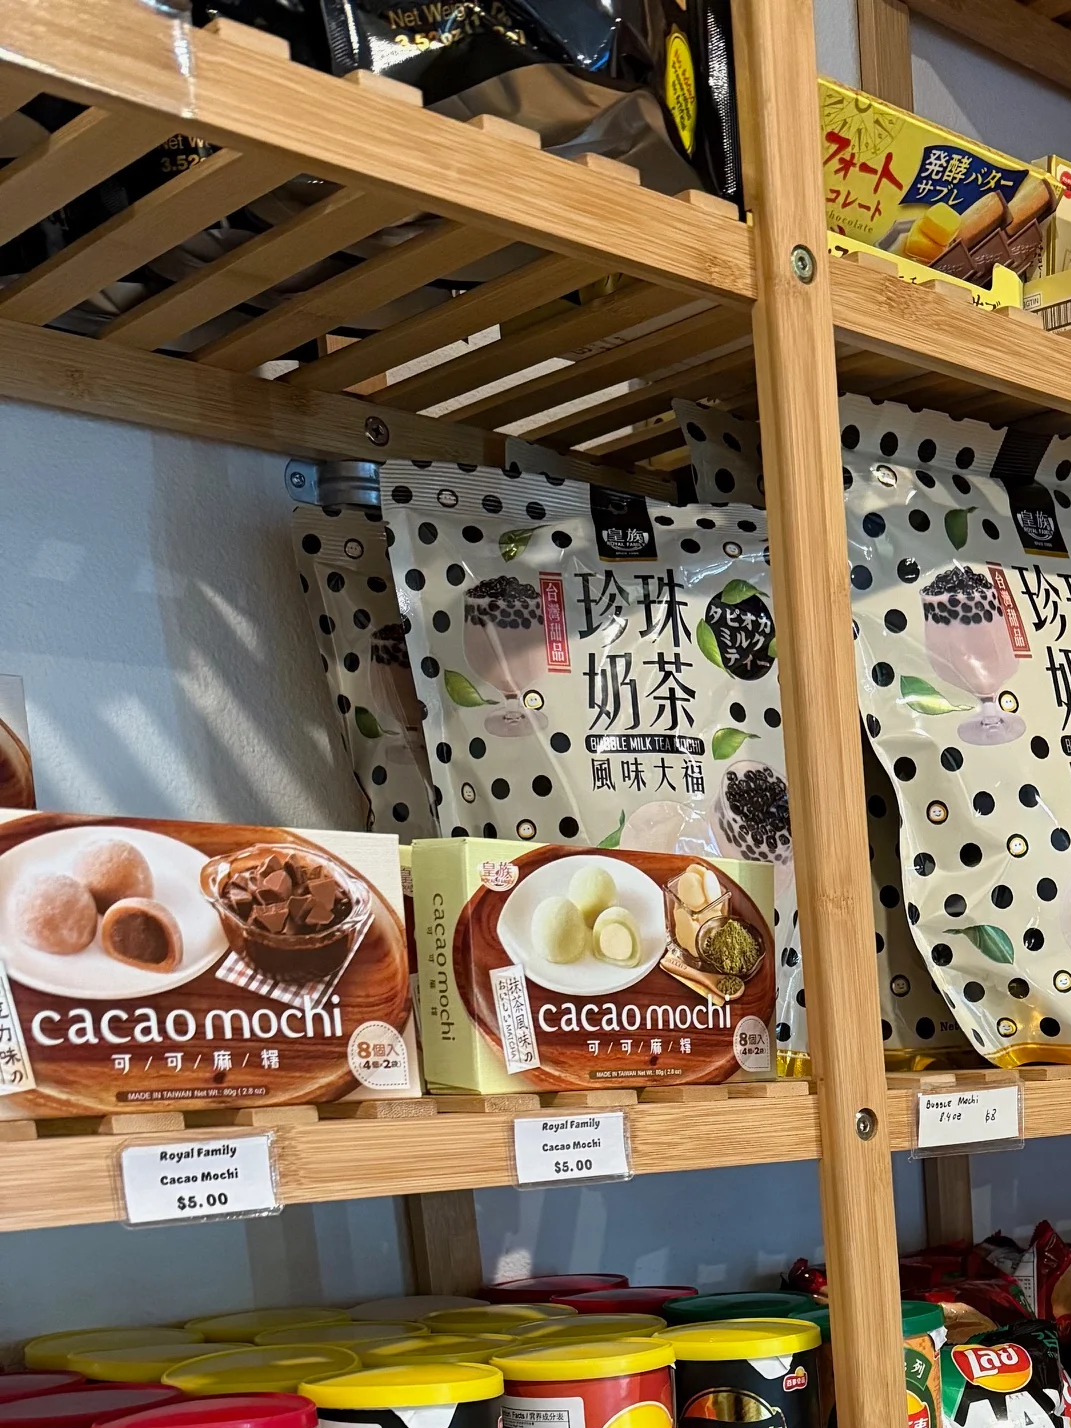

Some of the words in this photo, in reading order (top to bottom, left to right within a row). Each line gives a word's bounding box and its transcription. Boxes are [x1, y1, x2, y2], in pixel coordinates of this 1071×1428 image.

[824, 131, 904, 194] フォート
[922, 149, 1014, 192] 発酵バター
[916, 181, 964, 205] サブレ
[607, 528, 645, 543] 皇族
[573, 567, 693, 650] 珍珠
[709, 605, 772, 634] タピオカ
[720, 627, 766, 650] ミルク
[582, 651, 697, 733] 奶茶
[629, 736, 652, 752] MILK
[655, 736, 671, 752] TEA
[591, 757, 705, 794] 風味大福
[482, 860, 514, 880] 皇族
[31, 1007, 197, 1046] cacao
[205, 995, 344, 1041] mochi
[538, 1001, 641, 1033] cacao
[647, 994, 731, 1030] mochi
[739, 1032, 766, 1046] 8個入
[357, 1041, 400, 1059] 8個入
[128, 1092, 151, 1100] MADE
[163, 1089, 192, 1098] TAIWAN
[542, 1119, 568, 1132] Royal
[569, 1117, 601, 1131] Family
[160, 1149, 194, 1163] Royal
[197, 1144, 237, 1160] Family
[542, 1140, 571, 1152] Cacao
[572, 1138, 601, 1150] Mochi
[553, 1159, 593, 1173] $5.00
[160, 1173, 199, 1185] Cacao
[201, 1168, 239, 1182] Mochi
[177, 1192, 228, 1211] $5.00
